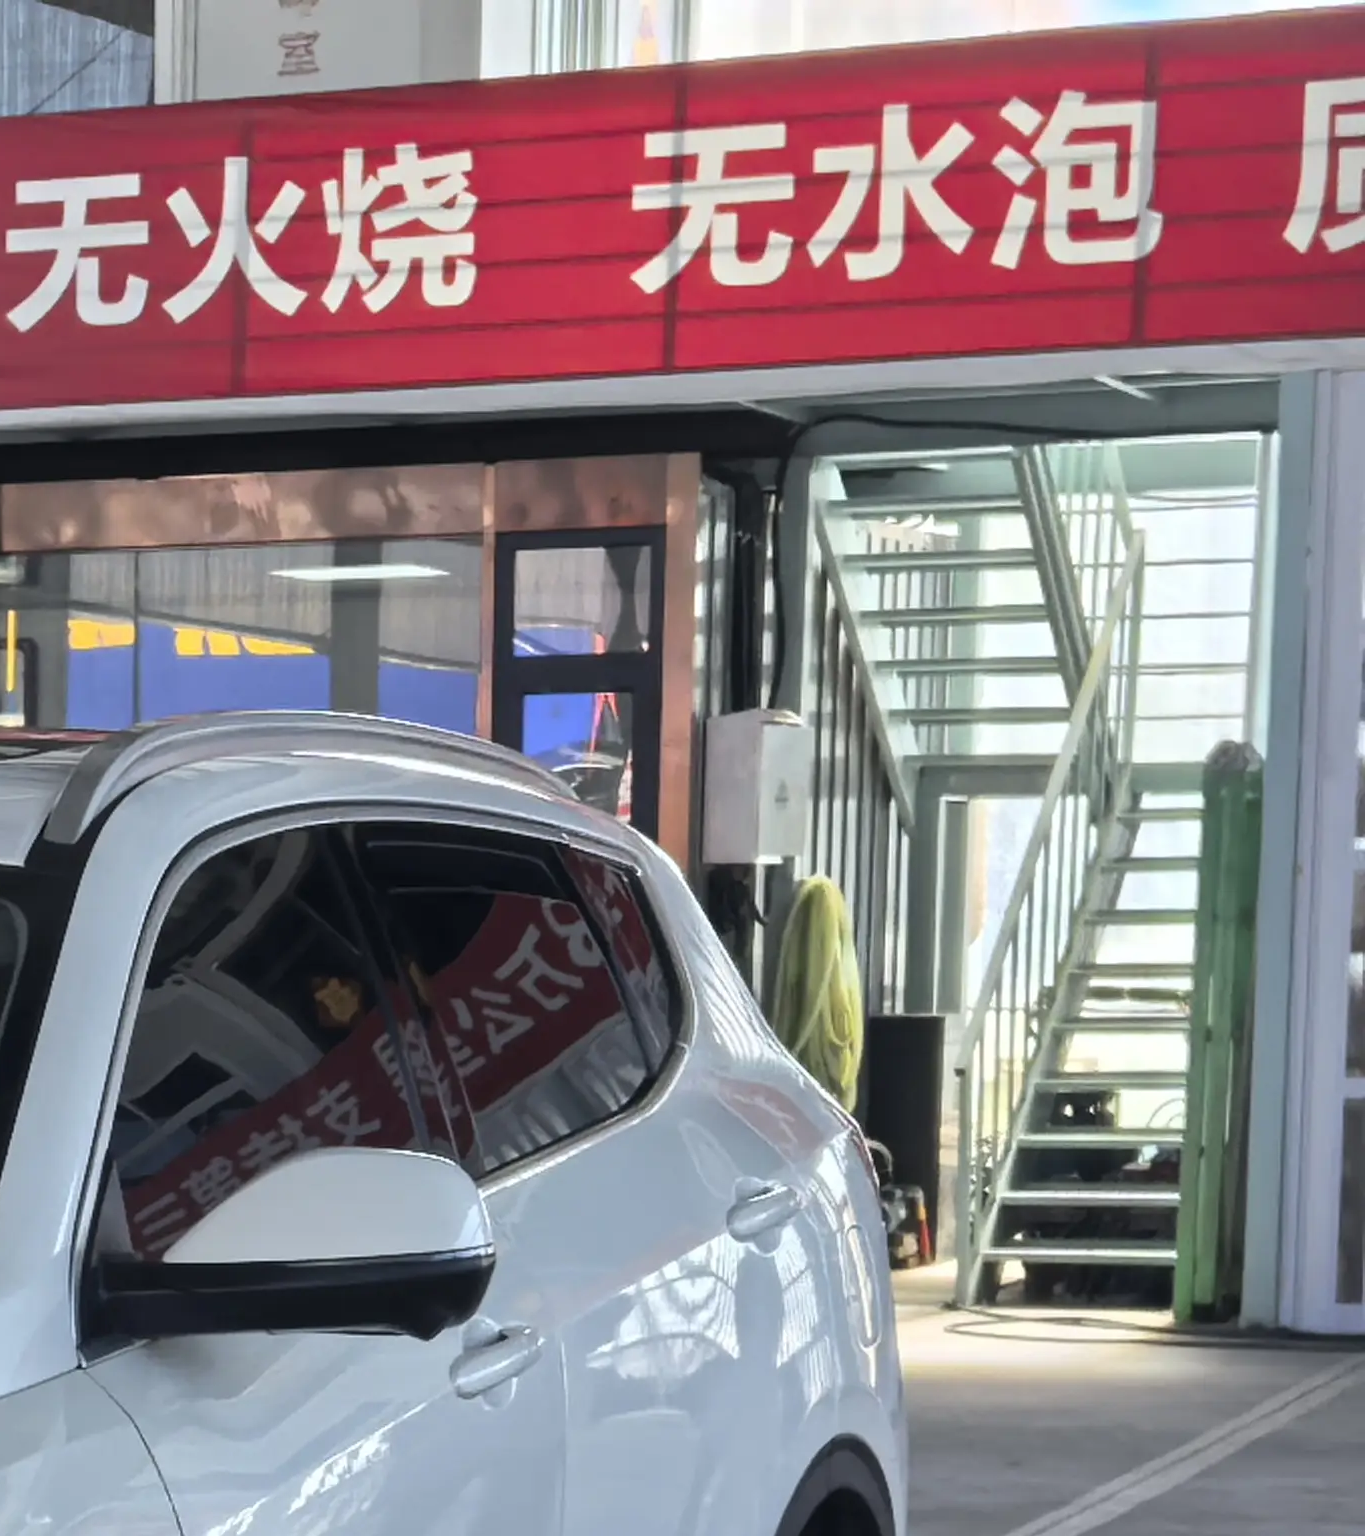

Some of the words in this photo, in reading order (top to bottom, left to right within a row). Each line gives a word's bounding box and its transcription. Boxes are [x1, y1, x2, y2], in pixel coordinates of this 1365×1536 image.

[4, 141, 479, 334] 无火烧
[628, 88, 1164, 295] 无水泡
